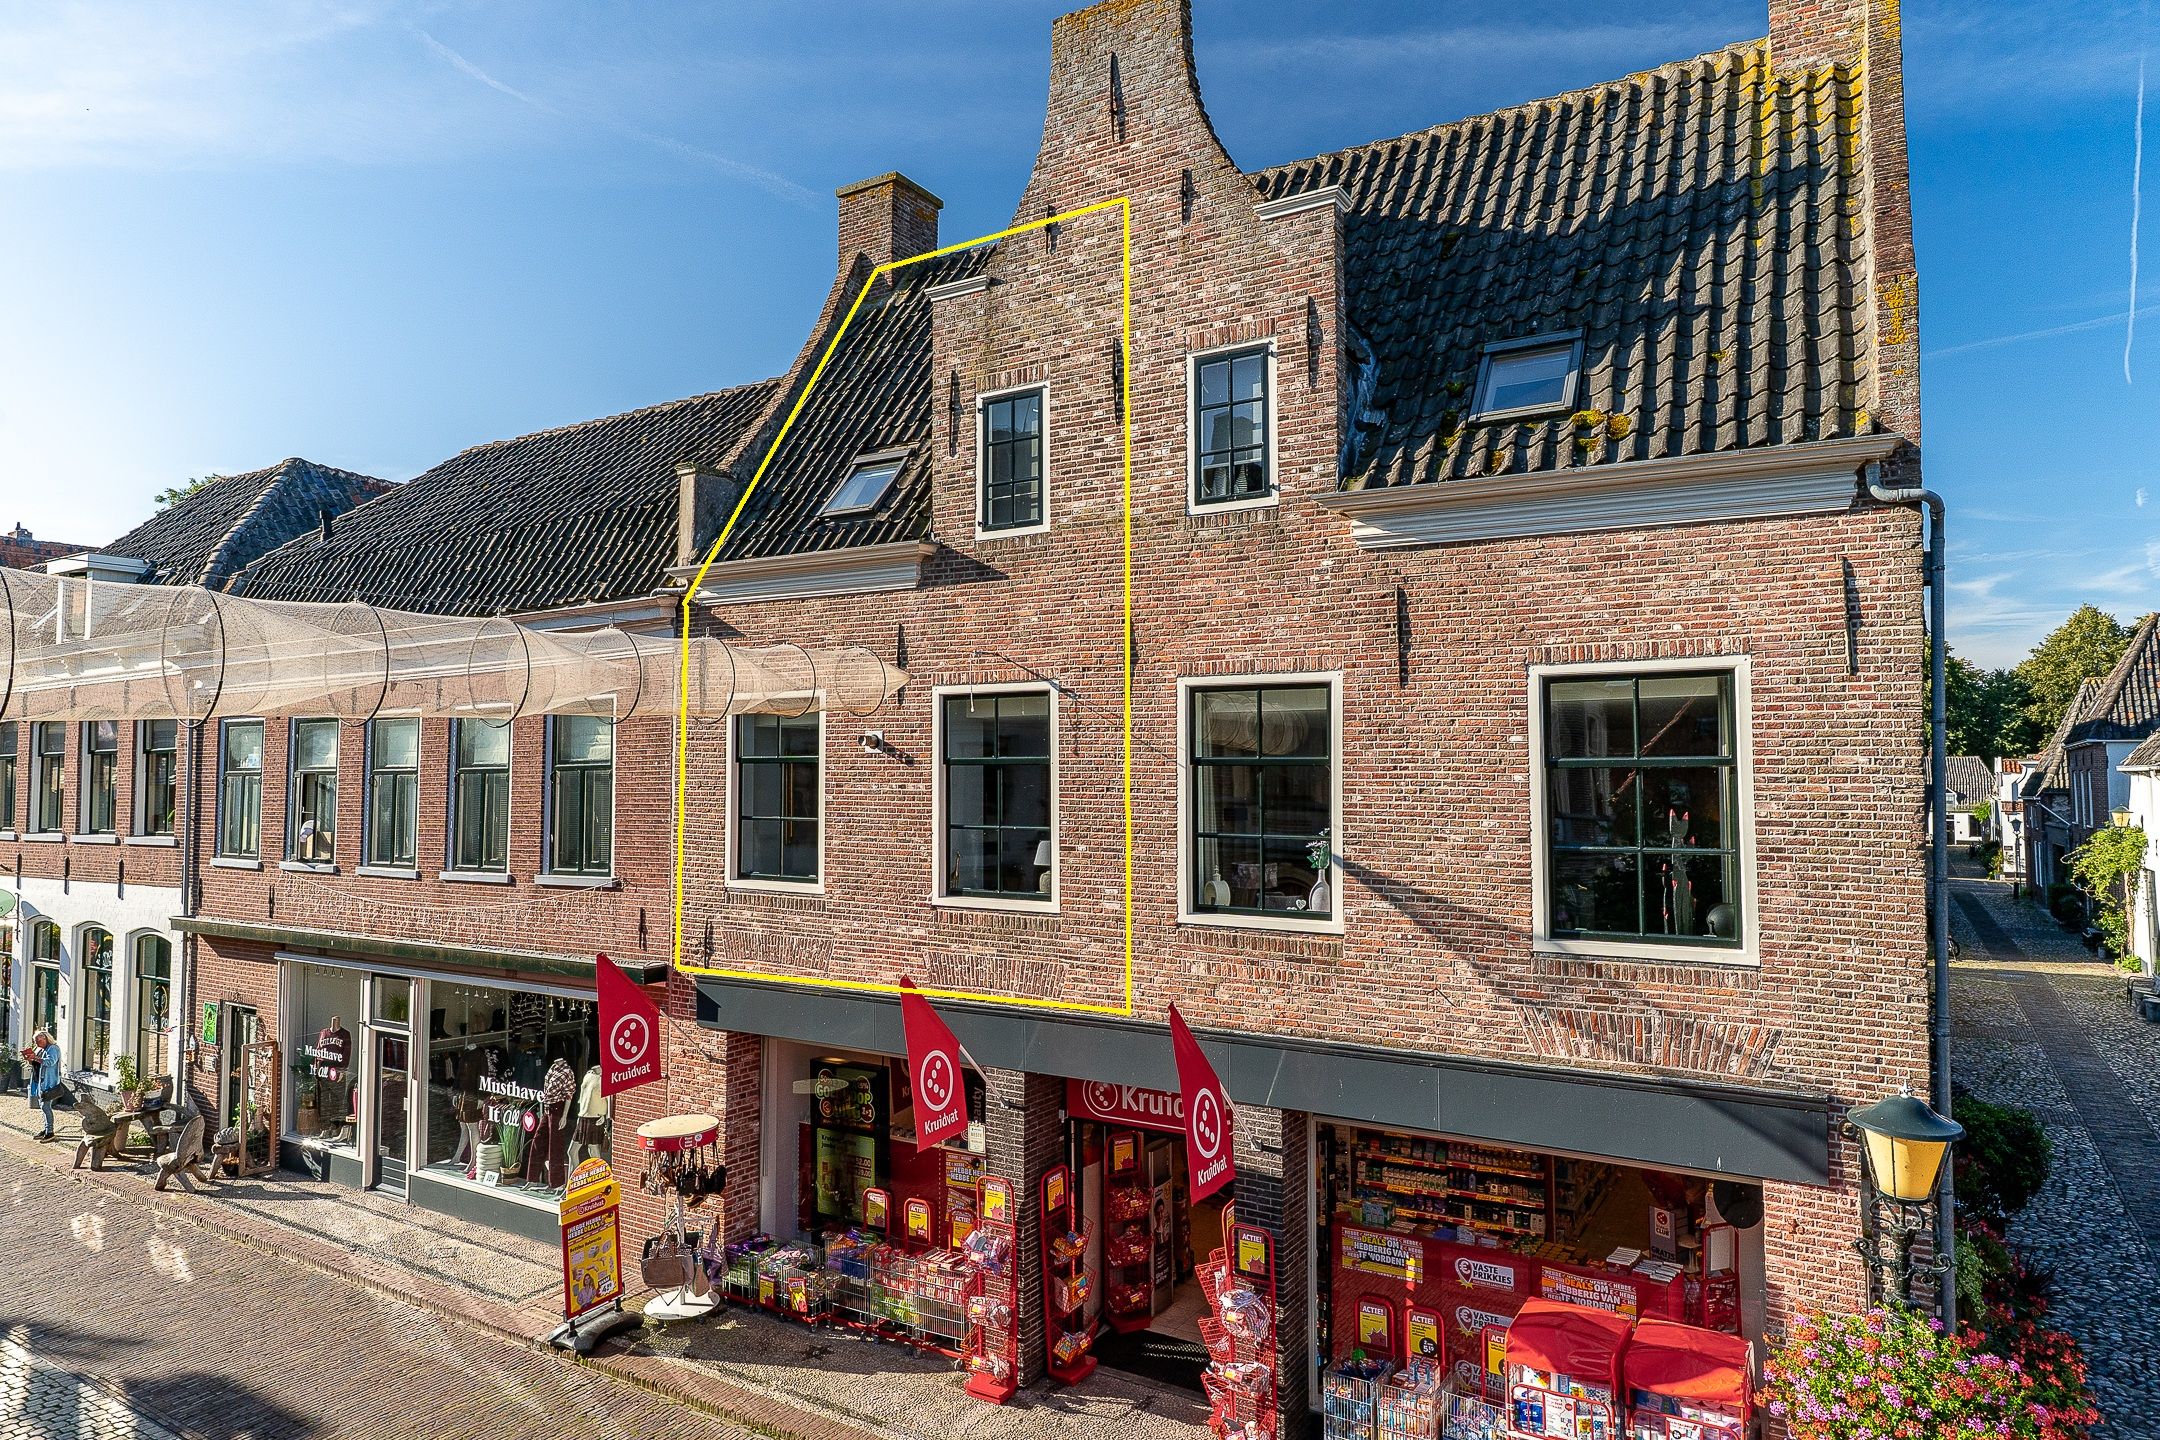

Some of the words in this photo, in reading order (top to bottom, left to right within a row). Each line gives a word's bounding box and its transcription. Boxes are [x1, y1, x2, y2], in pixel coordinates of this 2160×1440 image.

[320, 1037, 343, 1047] COLLEGE
[305, 1045, 342, 1062] Musthave
[309, 1064, 316, 1075] It
[611, 1062, 651, 1083] Kruidvat
[479, 1076, 545, 1102] Musthave
[488, 1105, 500, 1123] It
[503, 1109, 520, 1127] all
[924, 1109, 959, 1135] Kruidvat
[951, 1172, 970, 1182] HEBBE
[1197, 1154, 1228, 1187] Kruidvat
[1242, 1233, 1262, 1243] ACTIE!
[1362, 1236, 1386, 1247] DEALS
[1387, 1240, 1399, 1249] OM
[1354, 1241, 1392, 1255] HEBBERIG
[1393, 1248, 1410, 1259] VAN
[1368, 1252, 1405, 1267] WORDEN!
[1473, 1263, 1498, 1275] VASTE
[1473, 1271, 1512, 1284] PRIKKIES
[1563, 1277, 1593, 1290] DEALS
[1594, 1284, 1609, 1293] OM
[1555, 1283, 1600, 1300] HEBBERIG
[1601, 1293, 1621, 1305] VAN
[1362, 1305, 1383, 1315] ACTIE!
[1572, 1297, 1615, 1312] WORDEN!
[1411, 1315, 1434, 1325] ACTIE!
[1473, 1311, 1499, 1324] VASTE
[1491, 1334, 1505, 1343] ACT
